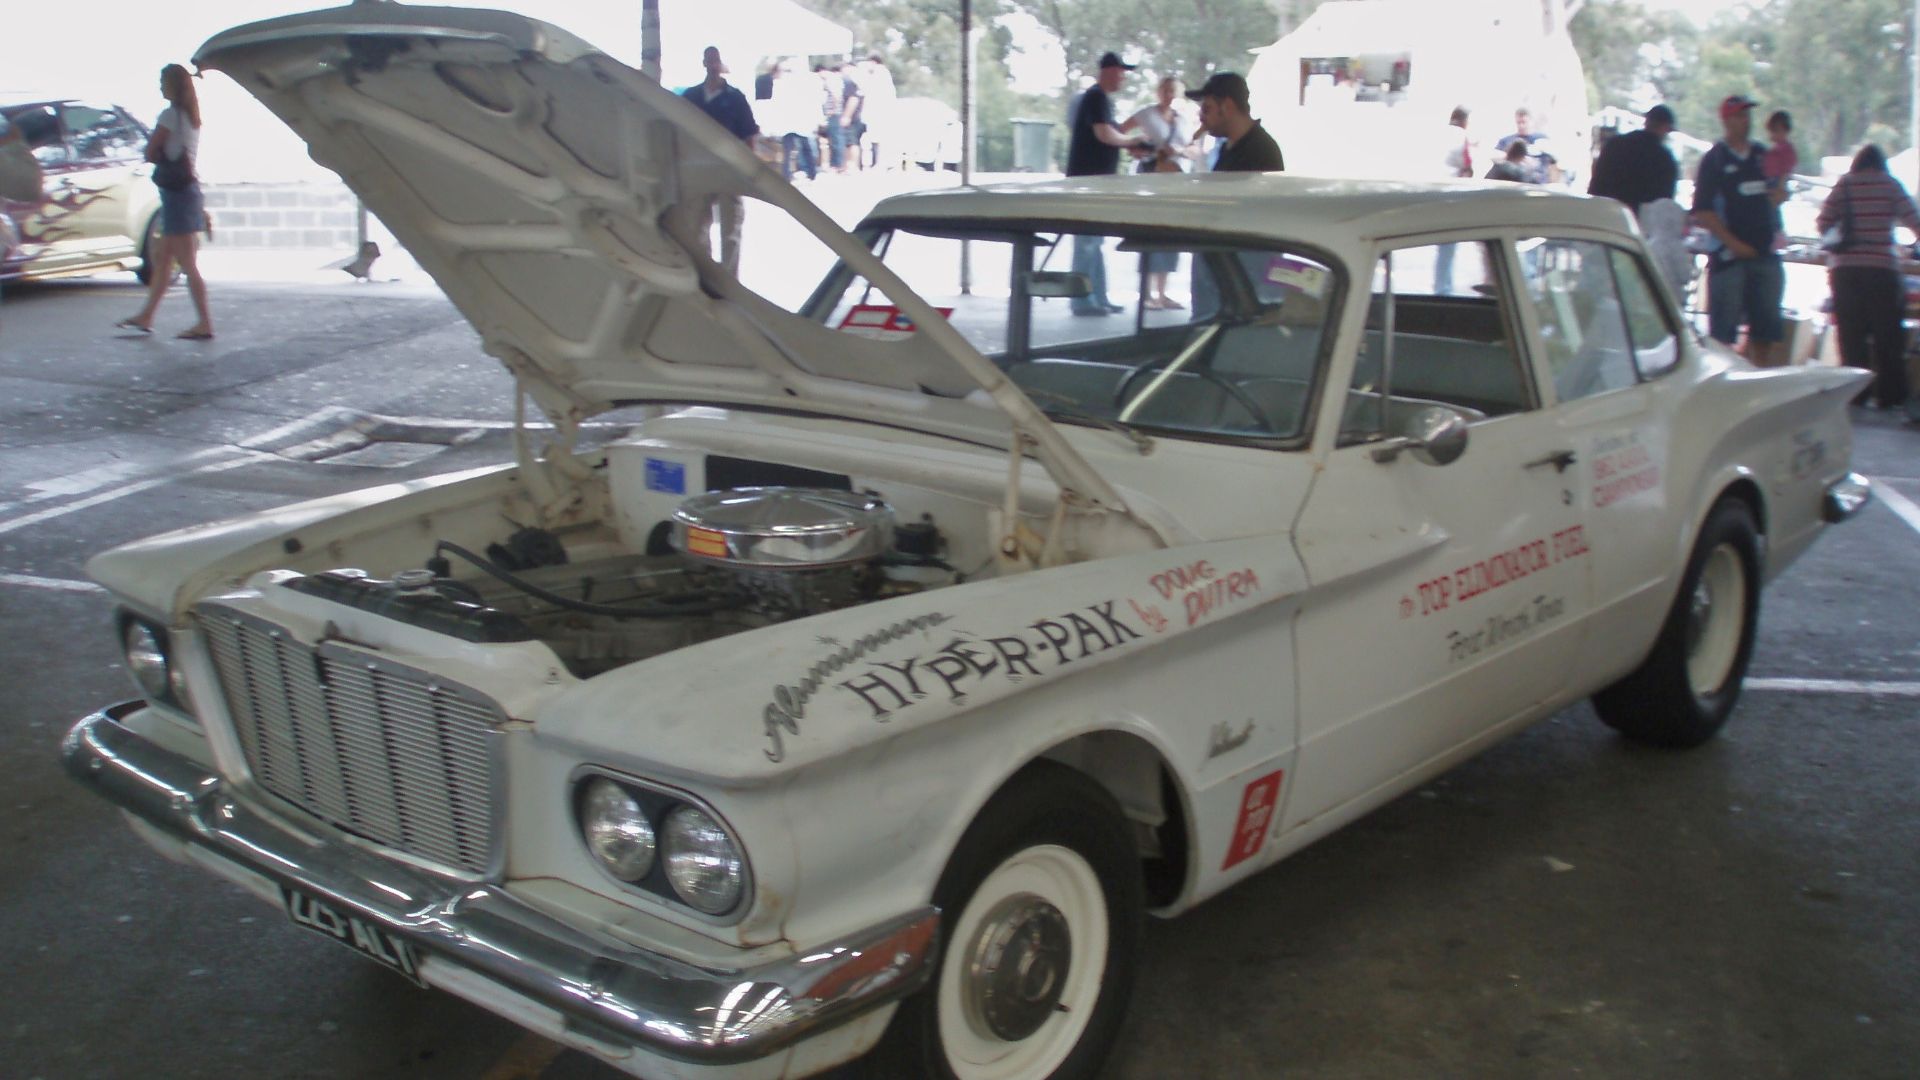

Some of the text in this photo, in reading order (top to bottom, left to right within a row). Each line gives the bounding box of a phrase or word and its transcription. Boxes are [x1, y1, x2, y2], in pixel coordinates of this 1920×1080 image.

[1183, 568, 1259, 626] DUTRA
[1417, 574, 1451, 616] TOP
[1454, 538, 1550, 602] ELIMINATOR
[1551, 524, 1591, 564] FUEL
[838, 600, 1145, 718] HYPER-PAK
